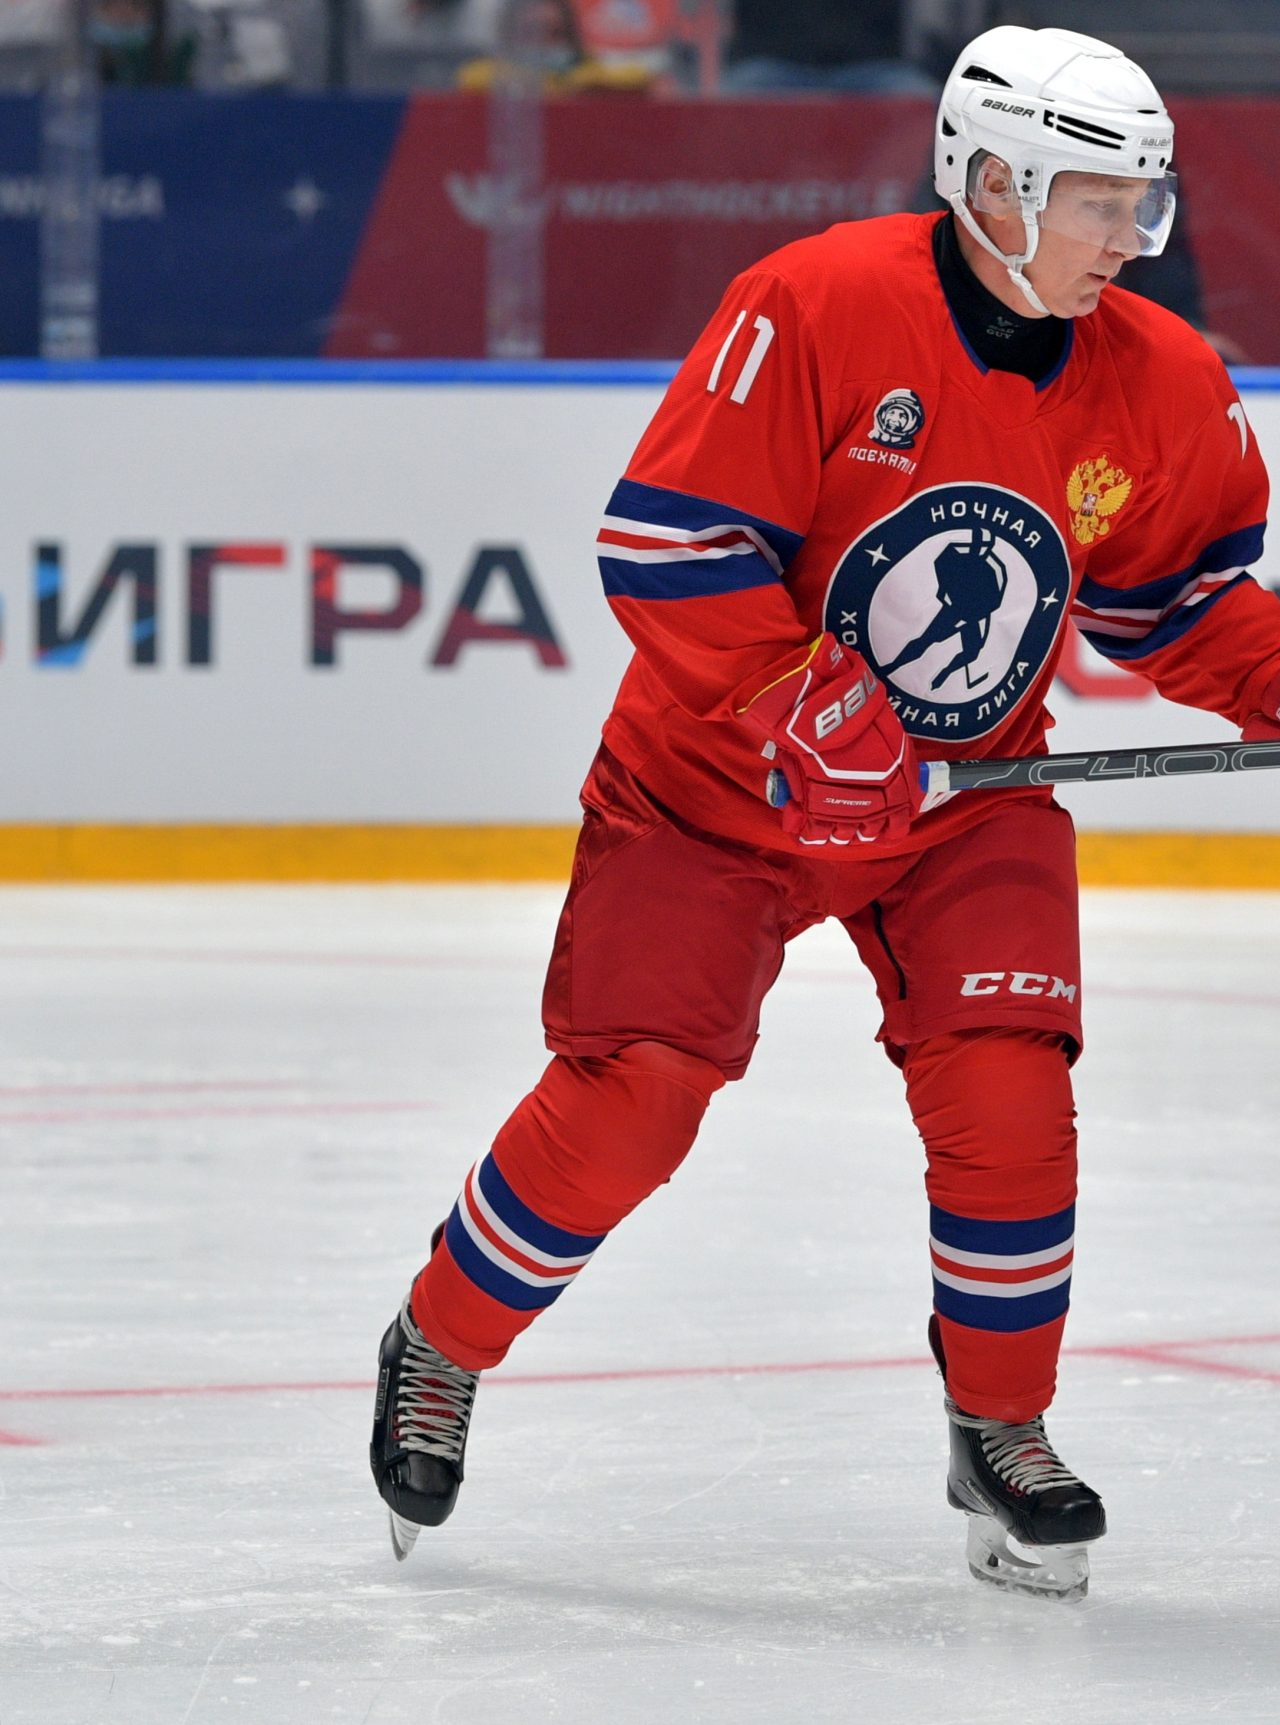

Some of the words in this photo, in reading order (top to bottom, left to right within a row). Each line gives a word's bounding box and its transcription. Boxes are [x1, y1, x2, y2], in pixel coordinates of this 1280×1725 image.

[706, 310, 775, 405] 11
[930, 501, 1041, 548] НОЧНАЯ
[977, 660, 1029, 720] ЛИГА
[960, 971, 1077, 1004] CCM
